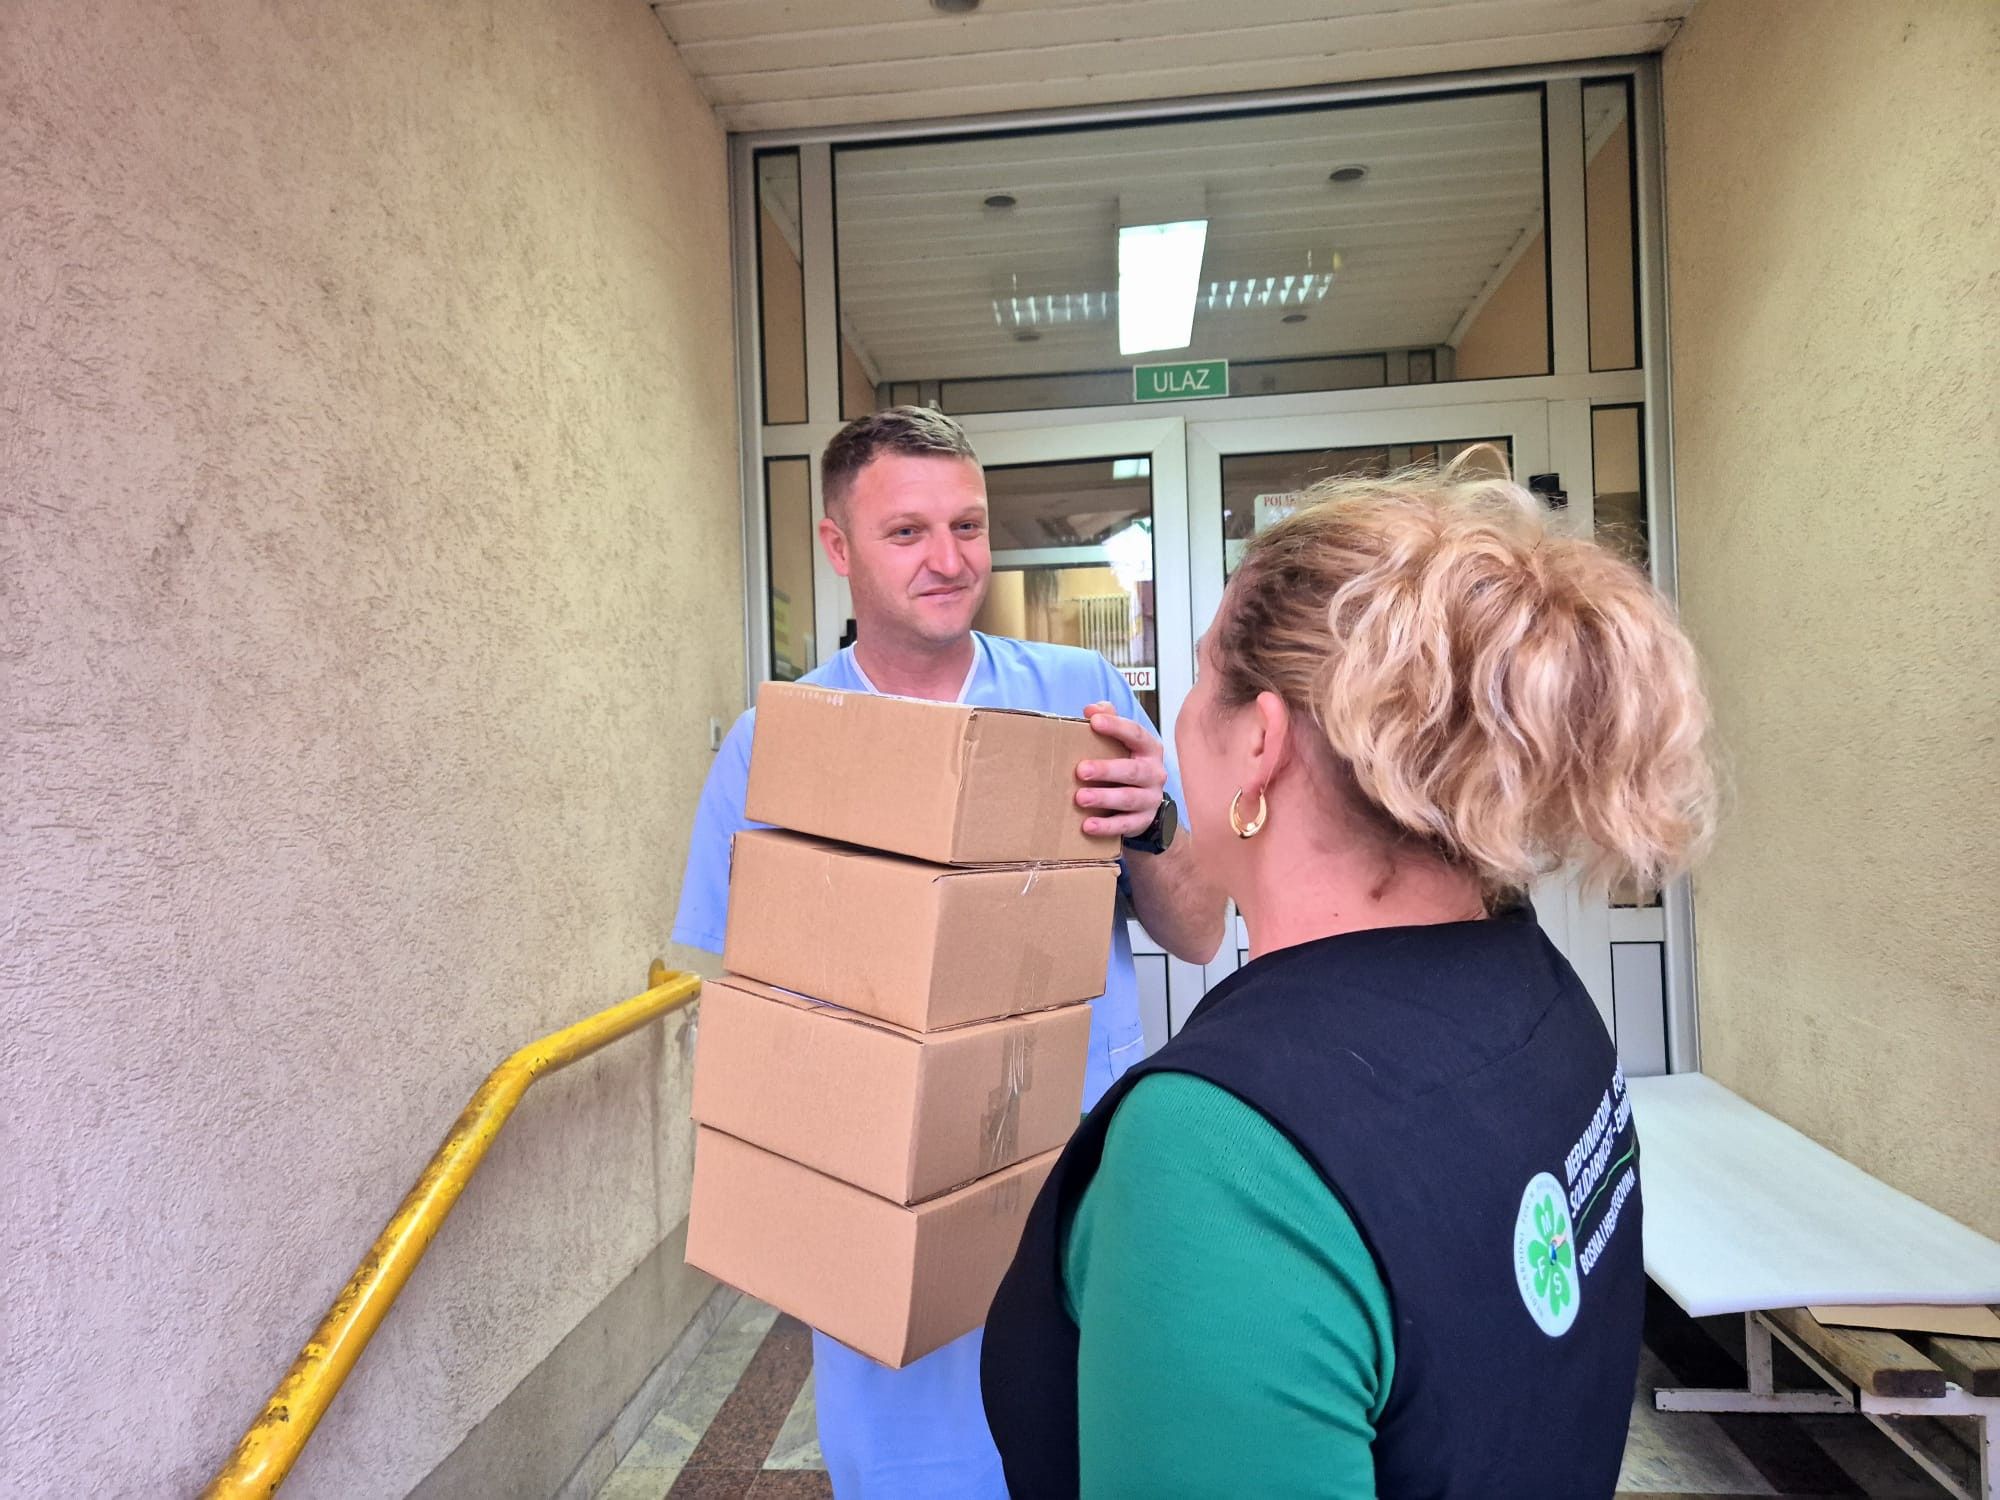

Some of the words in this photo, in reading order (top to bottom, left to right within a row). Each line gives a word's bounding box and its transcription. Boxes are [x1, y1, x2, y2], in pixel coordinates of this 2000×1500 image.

[1153, 369, 1210, 392] ULAZ
[1124, 671, 1151, 687] UCI
[1579, 1230, 1606, 1276] BOSNA
